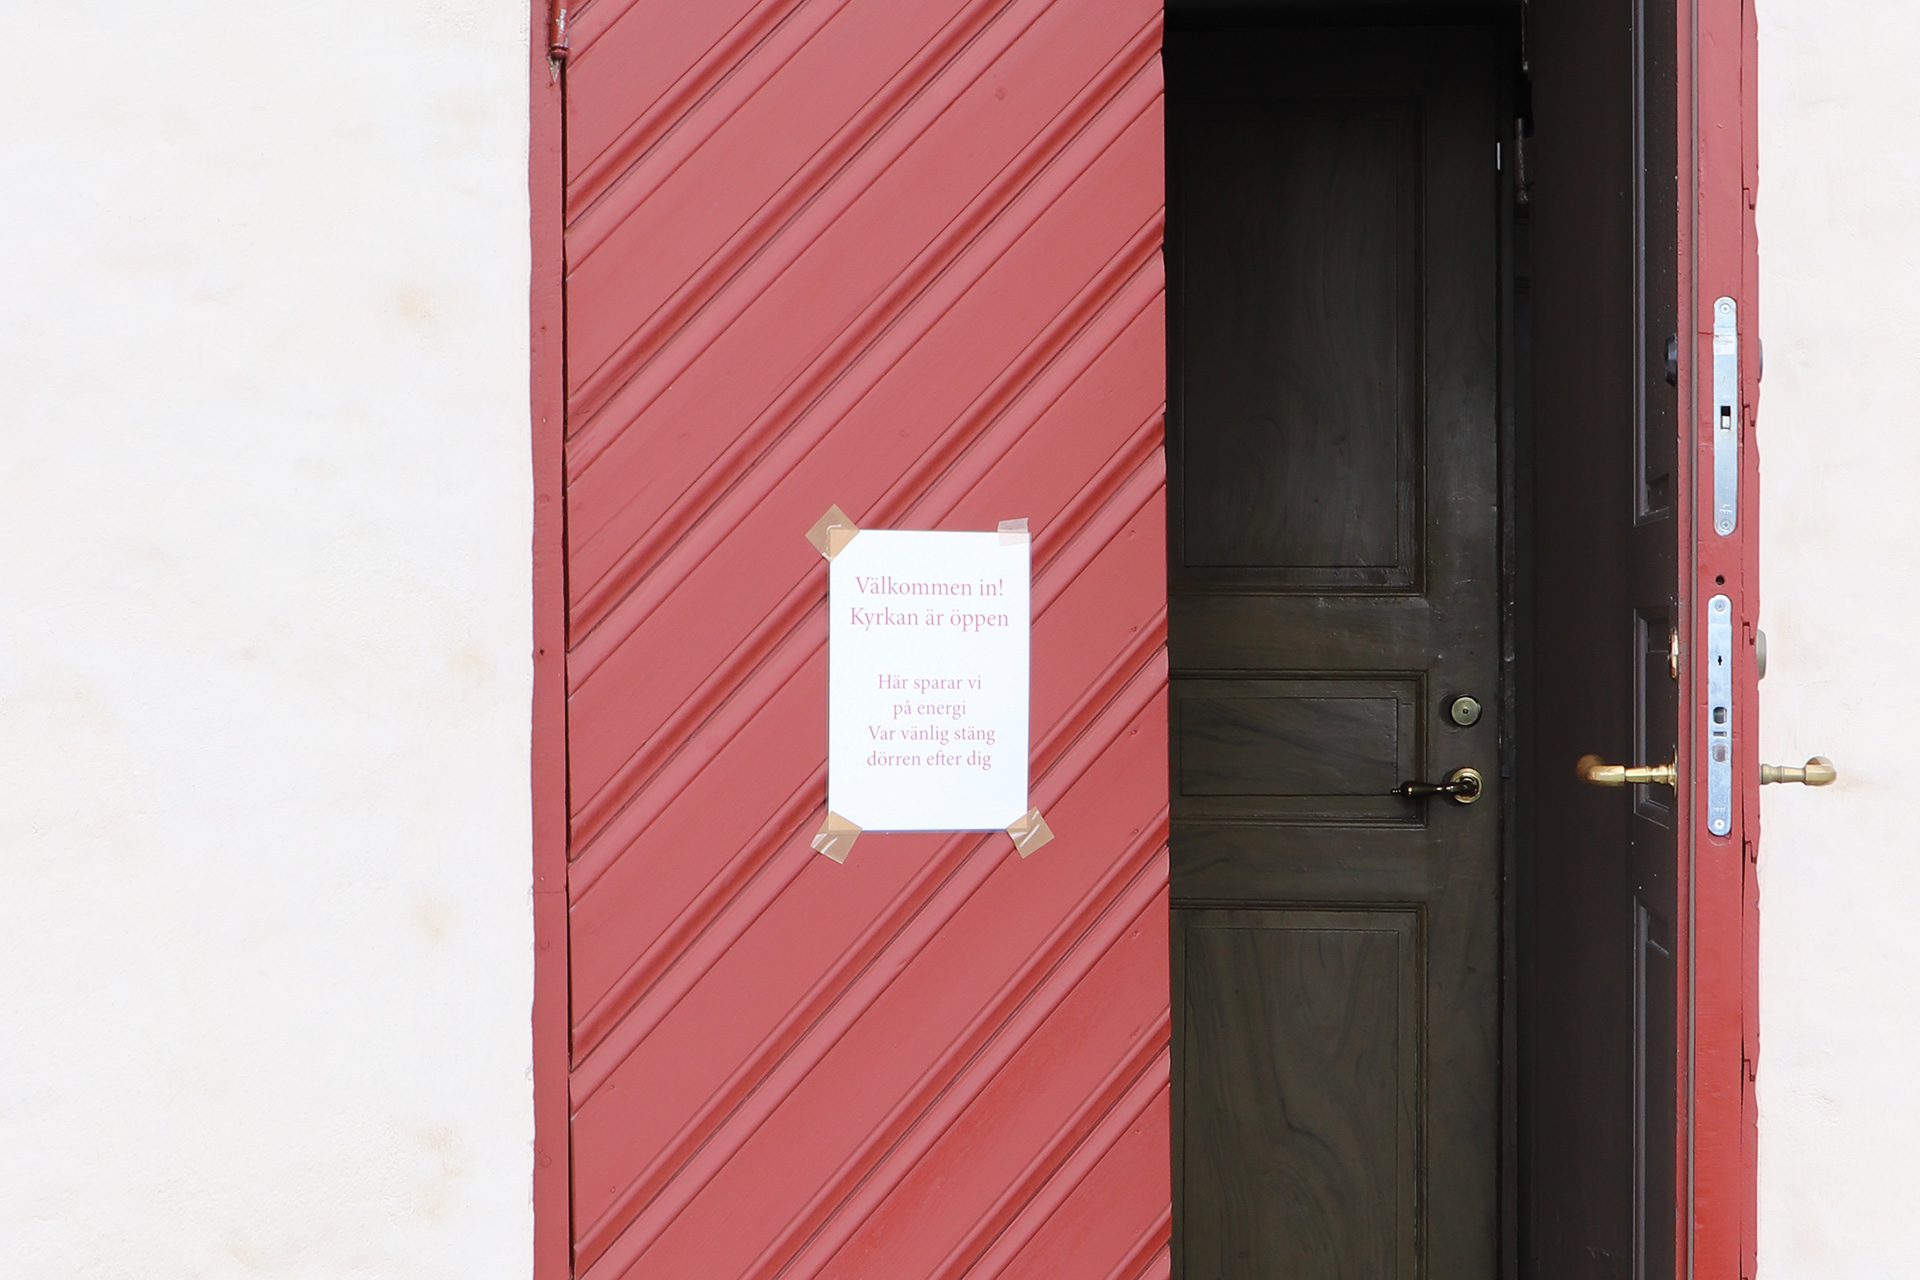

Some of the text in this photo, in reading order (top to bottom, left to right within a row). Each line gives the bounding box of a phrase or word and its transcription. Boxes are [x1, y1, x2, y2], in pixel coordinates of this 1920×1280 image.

[856, 576, 1003, 596] Välkommen in!
[850, 606, 1009, 632] Kyrkan är öppen
[878, 674, 982, 694] Här sparar vi
[893, 700, 966, 720] på energi
[868, 724, 995, 746] Var vänlig stäng
[867, 750, 991, 770] dörren efter dig
